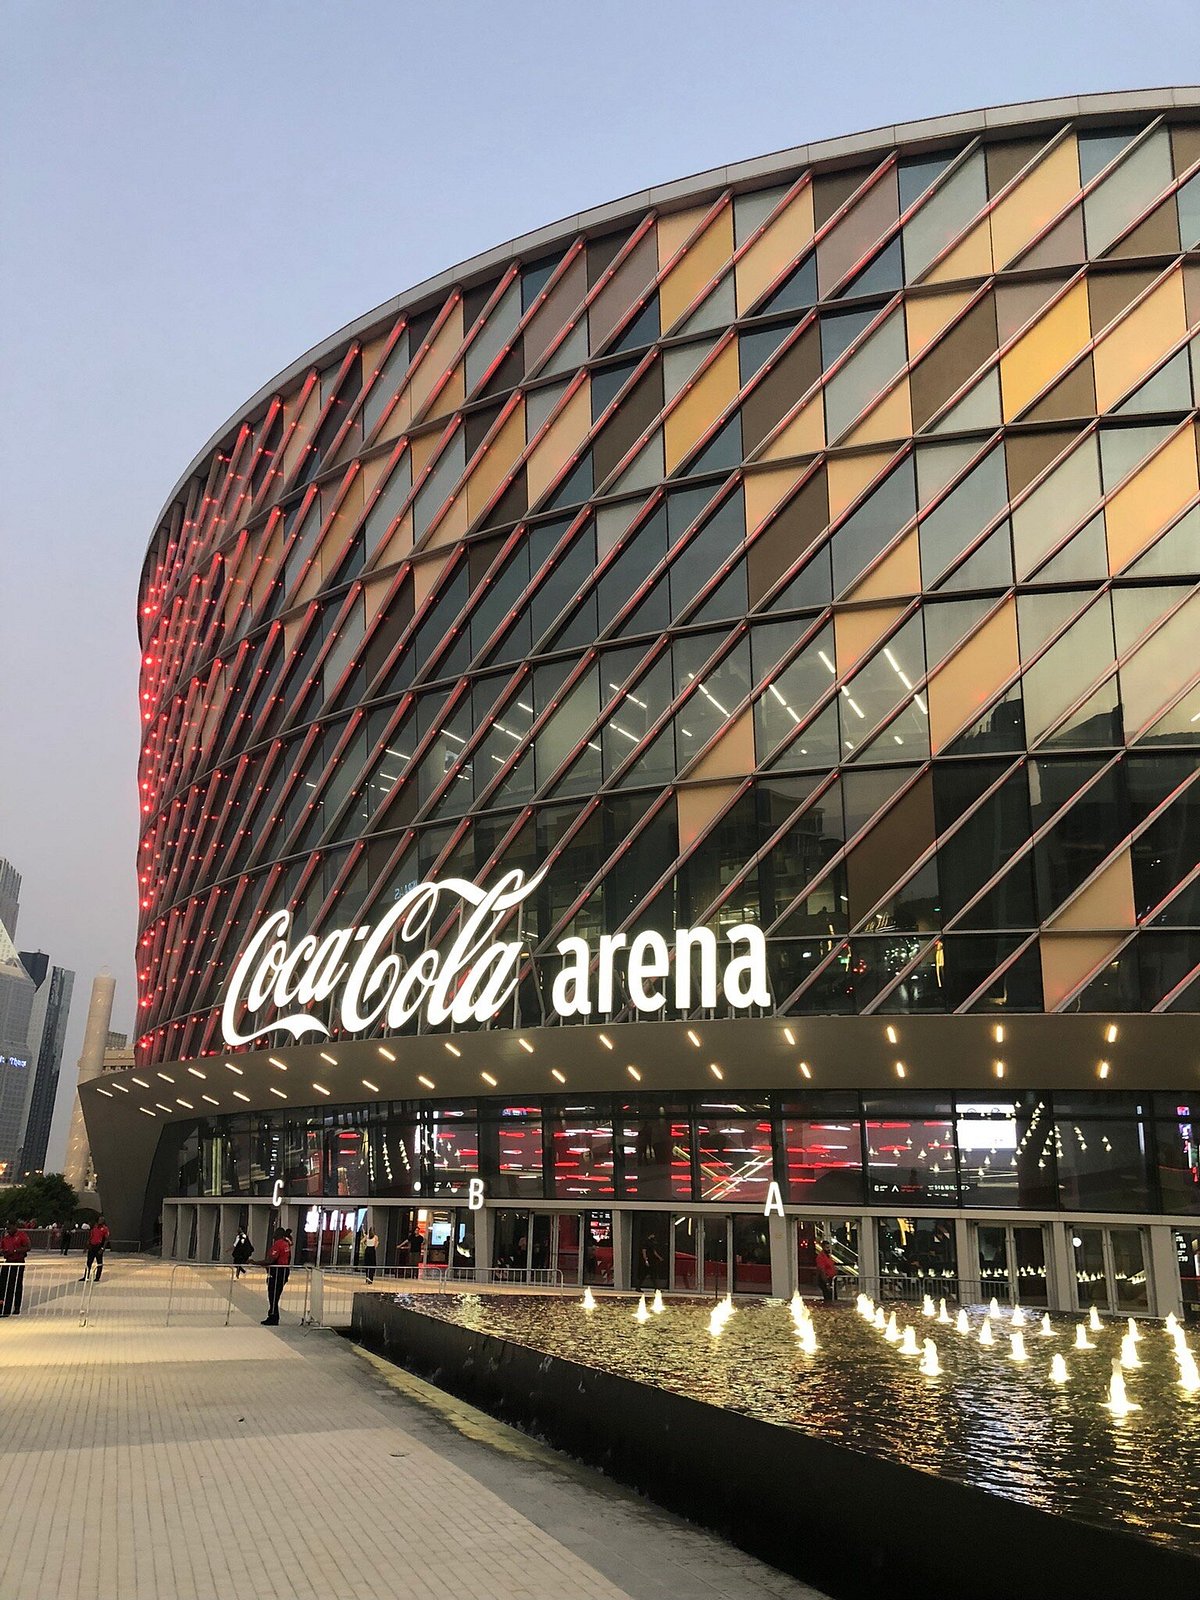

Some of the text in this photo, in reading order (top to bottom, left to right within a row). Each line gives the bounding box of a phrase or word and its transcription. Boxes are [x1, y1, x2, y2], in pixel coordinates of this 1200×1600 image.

[220, 864, 772, 1047] Coca-Cola arena
[272, 1179, 284, 1207] C
[468, 1178, 485, 1210] B
[763, 1181, 785, 1217] A
